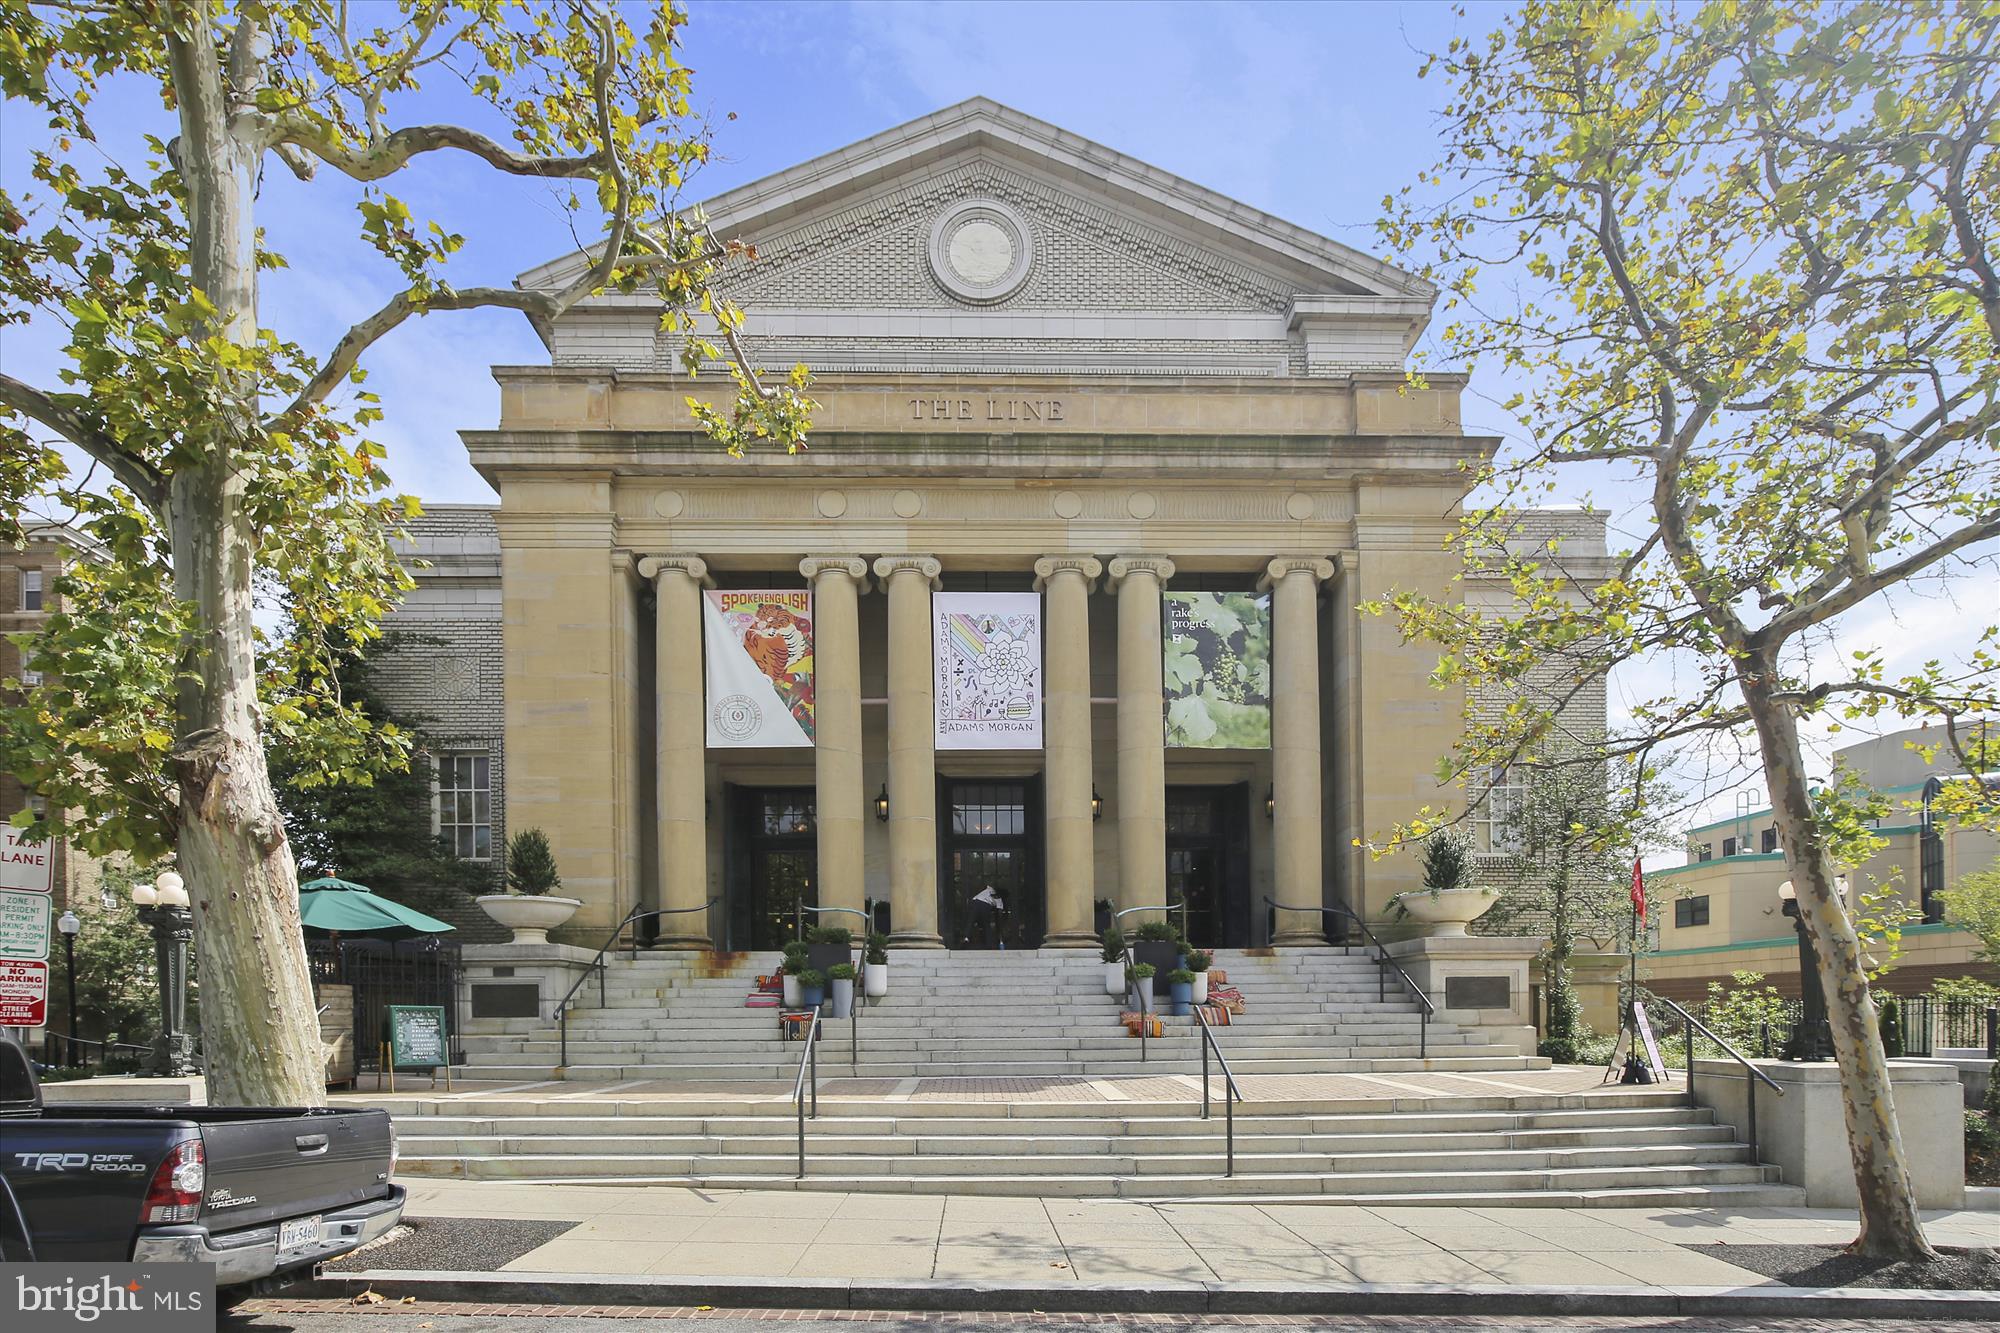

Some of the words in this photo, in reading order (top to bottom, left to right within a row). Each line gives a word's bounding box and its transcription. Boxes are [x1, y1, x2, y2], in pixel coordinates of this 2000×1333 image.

[908, 399, 974, 421] THE
[986, 399, 1064, 421] LINE
[1171, 598, 1178, 607] a
[1171, 607, 1200, 618] rake's
[1171, 619, 1216, 630] progress
[940, 612, 950, 655] ADAMS
[940, 656, 950, 708] MORGAN
[948, 722, 984, 732] ADAMS
[988, 722, 1033, 732] MORGAN
[1, 851, 45, 866] LANE
[6, 896, 29, 905] ZONE
[5, 913, 35, 922] PERMIT
[27, 923, 45, 931] ONLY
[0, 975, 42, 983] ARKING
[14, 1152, 90, 1171] TRD
[91, 1154, 133, 1162] OFF
[90, 1163, 147, 1172] ROAD
[208, 1195, 257, 1209] TACOMA
